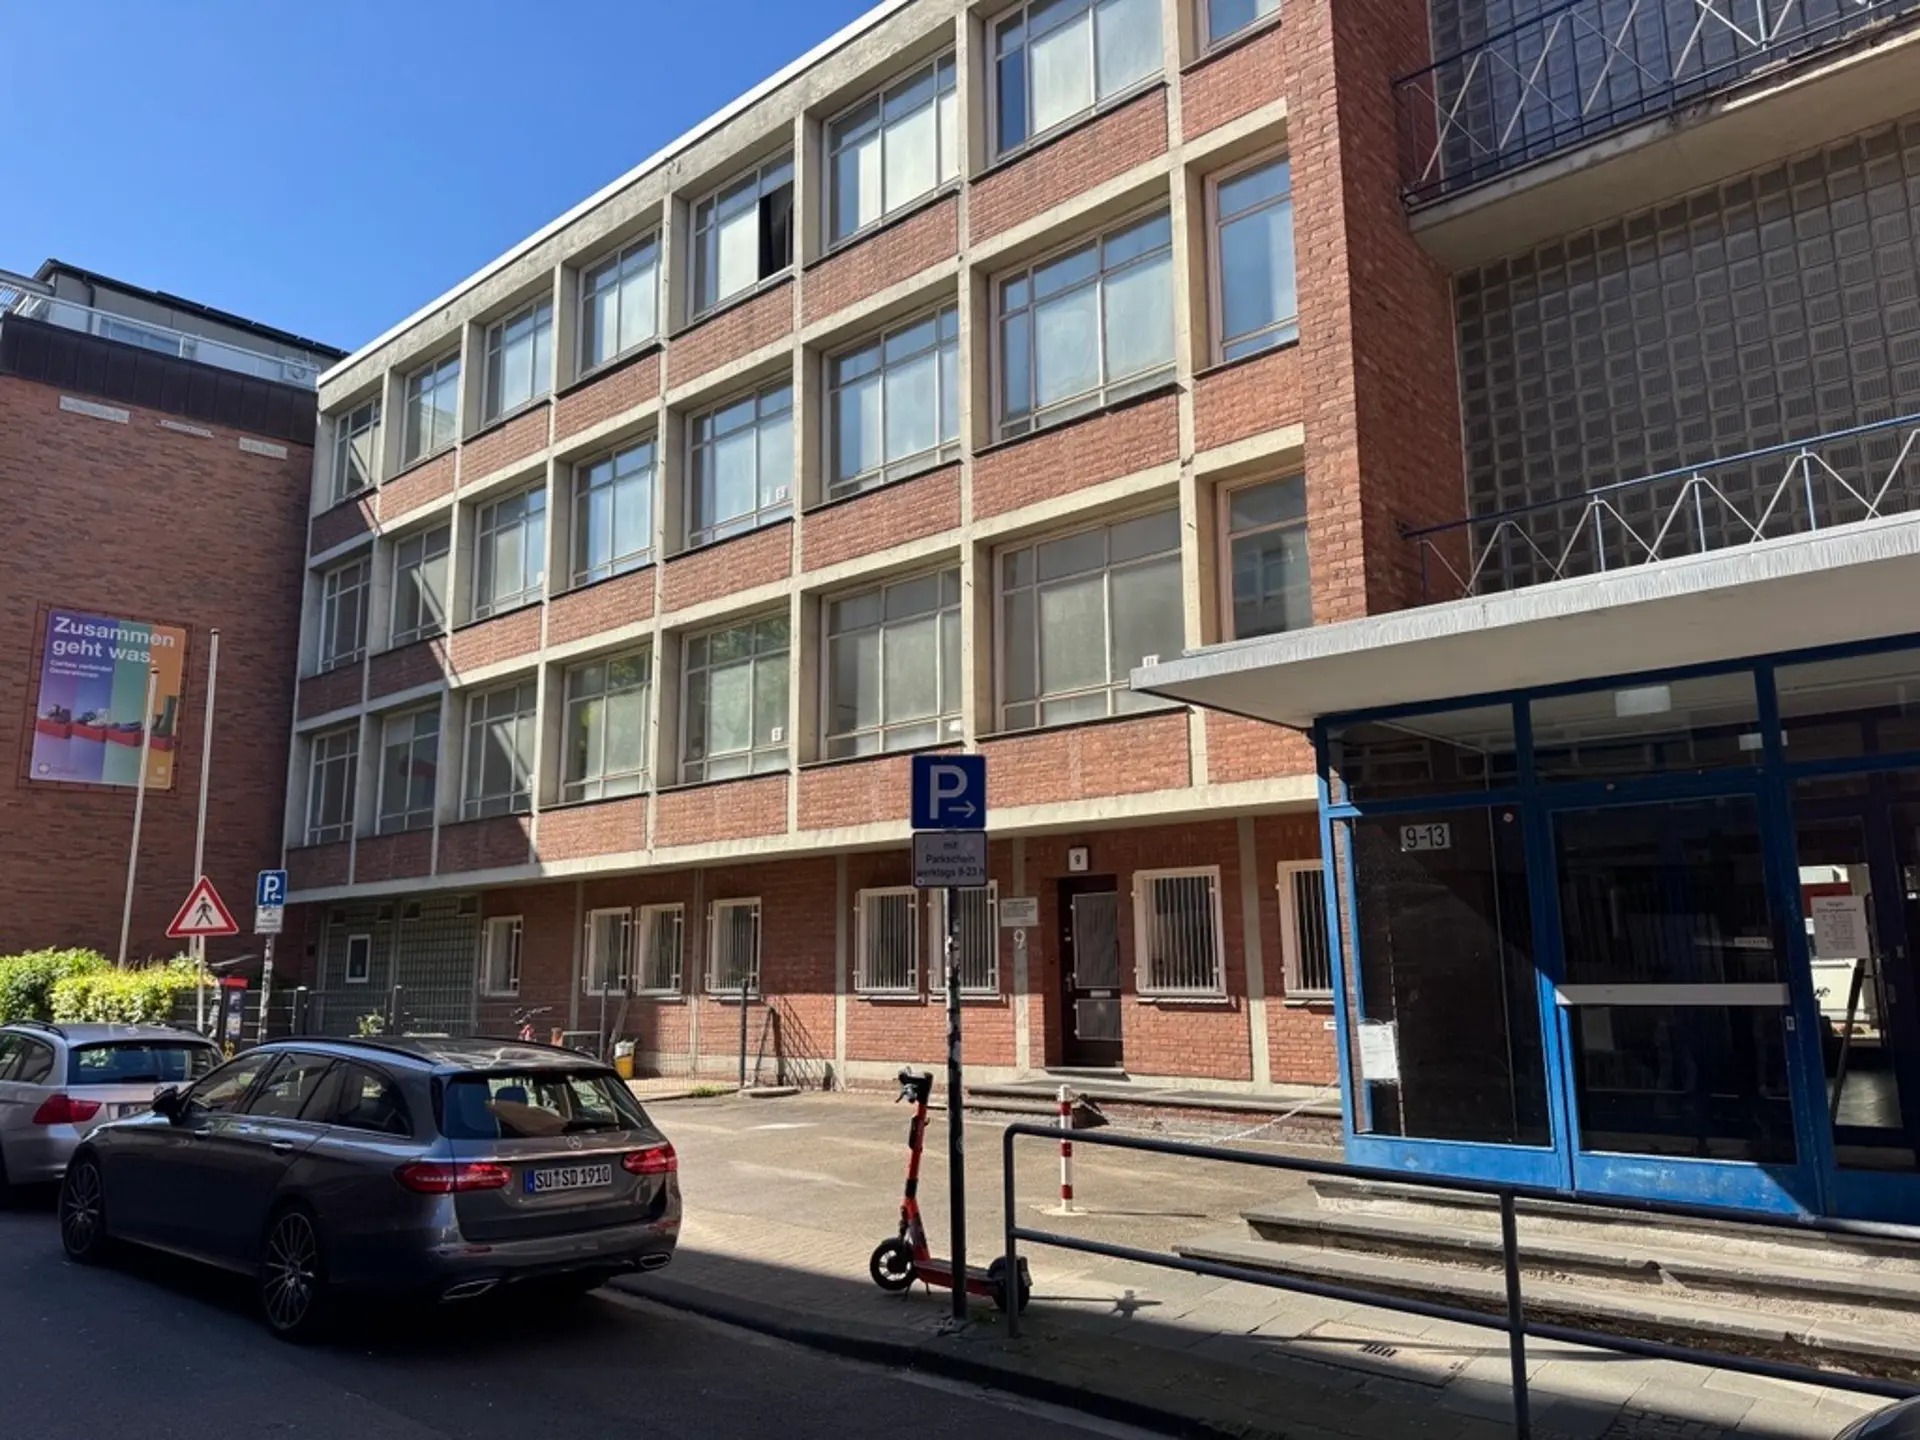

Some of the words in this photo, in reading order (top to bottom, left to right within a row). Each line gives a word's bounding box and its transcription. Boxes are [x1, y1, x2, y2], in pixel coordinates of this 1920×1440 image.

[53, 616, 175, 648] Zusammen
[52, 639, 102, 657] geht
[108, 646, 157, 664] was.
[929, 764, 968, 819] P
[943, 841, 958, 850] mit
[1405, 824, 1445, 848] 9-13
[925, 853, 976, 864] Parkschein
[1074, 854, 1081, 865] 9
[916, 868, 956, 879] werktags
[263, 875, 280, 902] P
[1013, 928, 1026, 950] 9
[535, 1171, 552, 1189] SU
